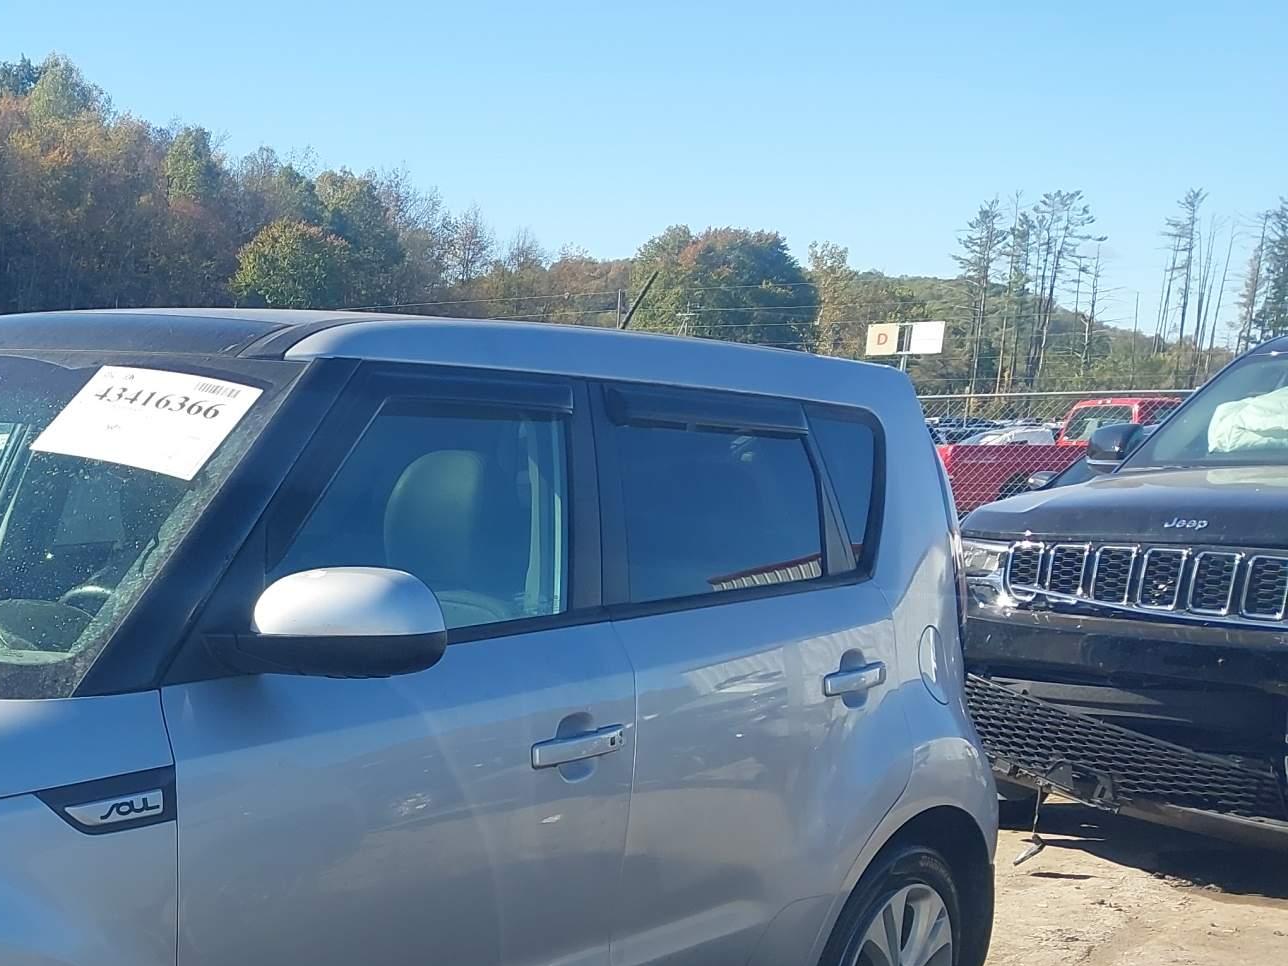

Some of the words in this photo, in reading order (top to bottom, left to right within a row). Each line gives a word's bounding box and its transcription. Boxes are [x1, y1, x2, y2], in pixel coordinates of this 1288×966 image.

[876, 332, 888, 345] D
[94, 384, 226, 420] 43416366
[1163, 516, 1209, 531] Jeep
[100, 797, 160, 820] SOUL
